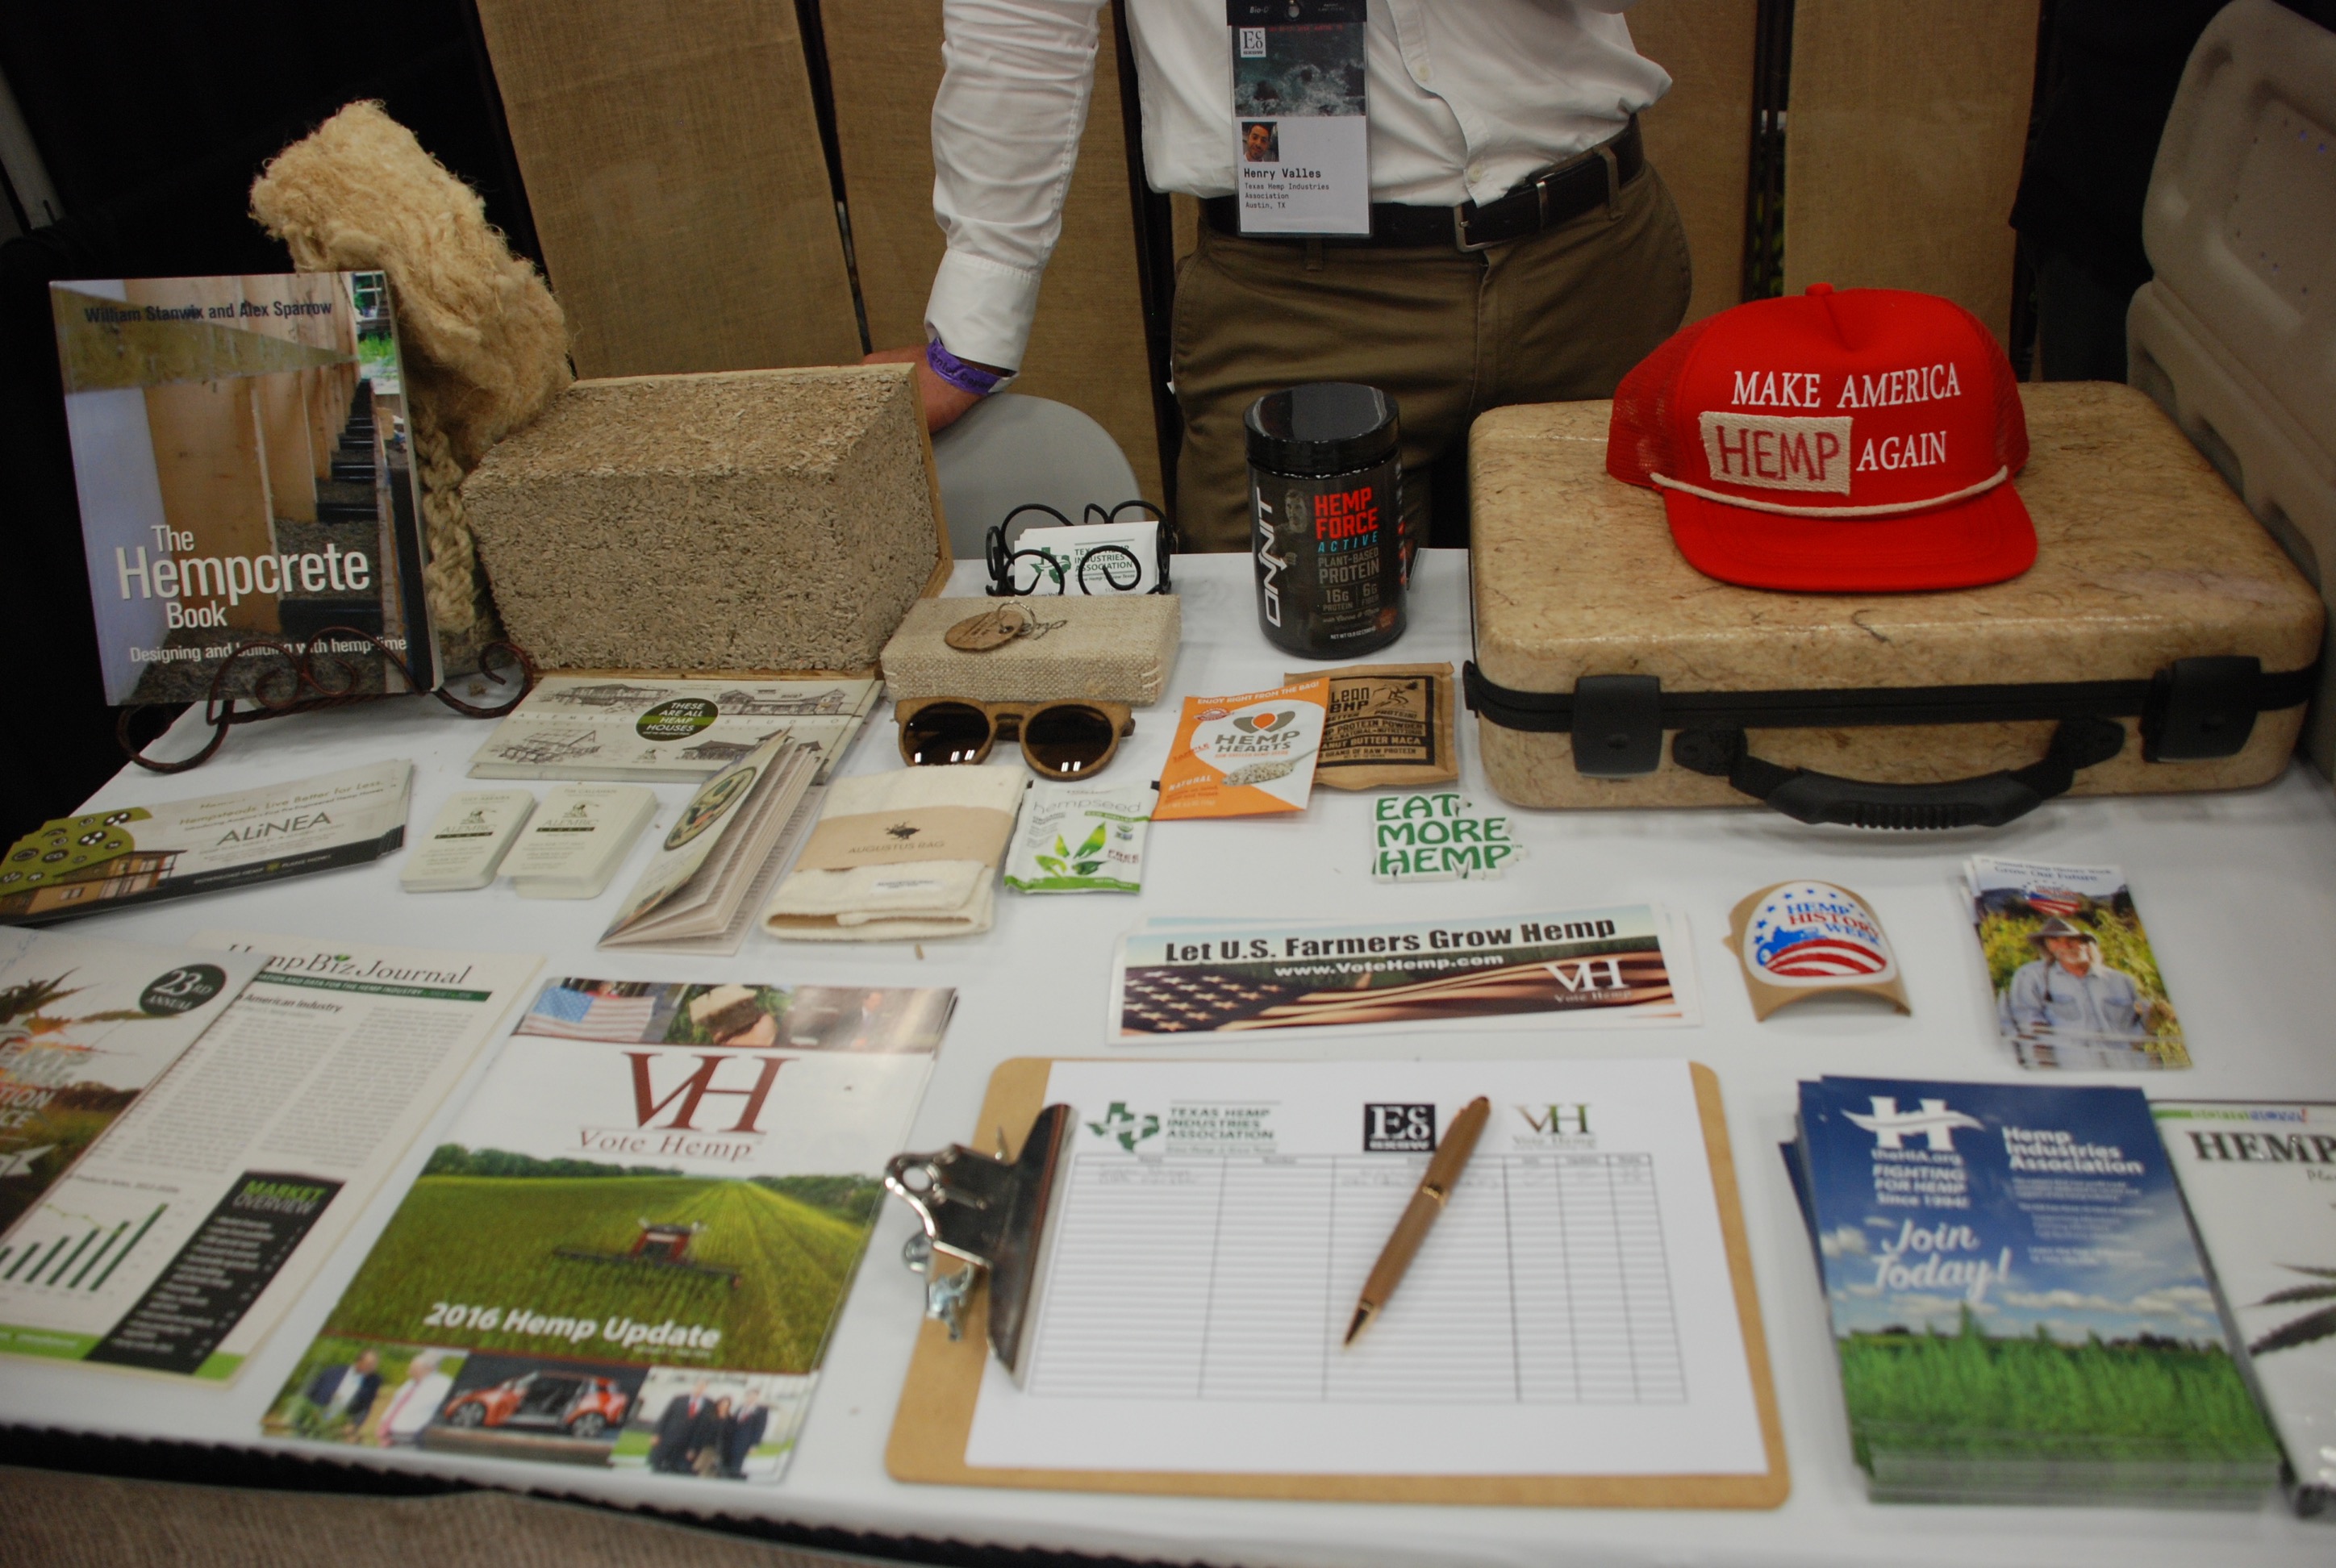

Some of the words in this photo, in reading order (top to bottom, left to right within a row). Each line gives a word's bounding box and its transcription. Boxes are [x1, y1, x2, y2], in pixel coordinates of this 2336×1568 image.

[1243, 168, 1275, 180] Henry
[1282, 168, 1321, 178] Valles
[85, 307, 140, 323] William
[146, 304, 203, 320] Stanwix
[209, 302, 234, 319] and
[240, 301, 269, 317] Alex
[274, 299, 332, 319] Sparrow
[1731, 371, 1821, 408] MAKE
[1837, 362, 1962, 408] AMERICA
[1717, 425, 1840, 482] HEMP
[1856, 431, 1947, 472] AGAIN
[1314, 486, 1373, 517] HEMP
[1316, 507, 1380, 540] FORCE
[151, 524, 194, 553] The
[1318, 531, 1379, 553] ACTIVE
[1074, 548, 1100, 557] TEX
[1074, 553, 1125, 565] INUSTRIES
[1318, 547, 1379, 568] PLANT-BASED
[117, 543, 370, 606] Hempcrete
[1075, 561, 1133, 572] SSOCATION
[1319, 557, 1380, 584] PROTEIN
[165, 600, 227, 629] Book
[130, 645, 201, 664] Designing
[205, 643, 232, 659] and
[297, 640, 327, 655] wth
[1227, 694, 1253, 703] RIGHT
[1255, 691, 1279, 700] FROM
[1299, 682, 1320, 690] BAG!
[670, 702, 706, 710] THESE
[646, 724, 695, 732] HOUSES
[660, 716, 694, 724] HEMP
[1337, 719, 1379, 733] PROTEIN
[1215, 730, 1300, 745] HEMP
[1217, 741, 1291, 753] HEARTS
[1322, 740, 1348, 749] ANUT
[1350, 736, 1388, 748] BUTTER
[1391, 736, 1421, 745] MACA
[1384, 746, 1416, 754] PROTEIN
[1168, 774, 1212, 792] NATURAL
[1033, 799, 1141, 814] hempseed
[1376, 794, 1460, 821] EAT
[1378, 817, 1511, 848] MORE
[849, 843, 915, 854] AUGUSTUS
[1380, 844, 1512, 875] HEMP
[1787, 903, 1850, 915] HEMP
[1790, 912, 1879, 938] HISTORY
[1825, 923, 1880, 947] WEEK
[1166, 941, 1212, 962] Let
[1220, 938, 1276, 960] U.S.
[1286, 934, 1420, 957] Farmers
[1429, 928, 1512, 949] Grow
[1520, 919, 1616, 943] Hemp
[1274, 953, 1504, 977] www.VoteHemp.com
[1542, 957, 1630, 993] VH
[621, 1052, 800, 1136] VH
[1170, 1107, 1219, 1117] TEXAS
[1224, 1107, 1270, 1117] HEMP
[1513, 1104, 1596, 1135] VH
[1167, 1119, 1261, 1128] INDUSTRIES
[1166, 1130, 1274, 1140] ASSOCIATION
[2002, 1126, 2073, 1146] Hemp
[580, 1130, 646, 1153] Vote
[659, 1134, 753, 1162] Hemp
[2005, 1141, 2124, 1160] Industries
[1872, 1163, 1967, 1182] FIGHTING
[2009, 1155, 2146, 1178] Association
[242, 1180, 328, 1201] MARKET
[1875, 1178, 1911, 1192] FOR
[1913, 1181, 1967, 1194] HEMP
[232, 1194, 317, 1214] OVERVIEW
[1880, 1218, 1982, 1257] Join
[1871, 1246, 2013, 1307] Today!
[423, 1303, 502, 1331] 2016
[503, 1308, 599, 1344] Hemp
[603, 1316, 722, 1349] Update
